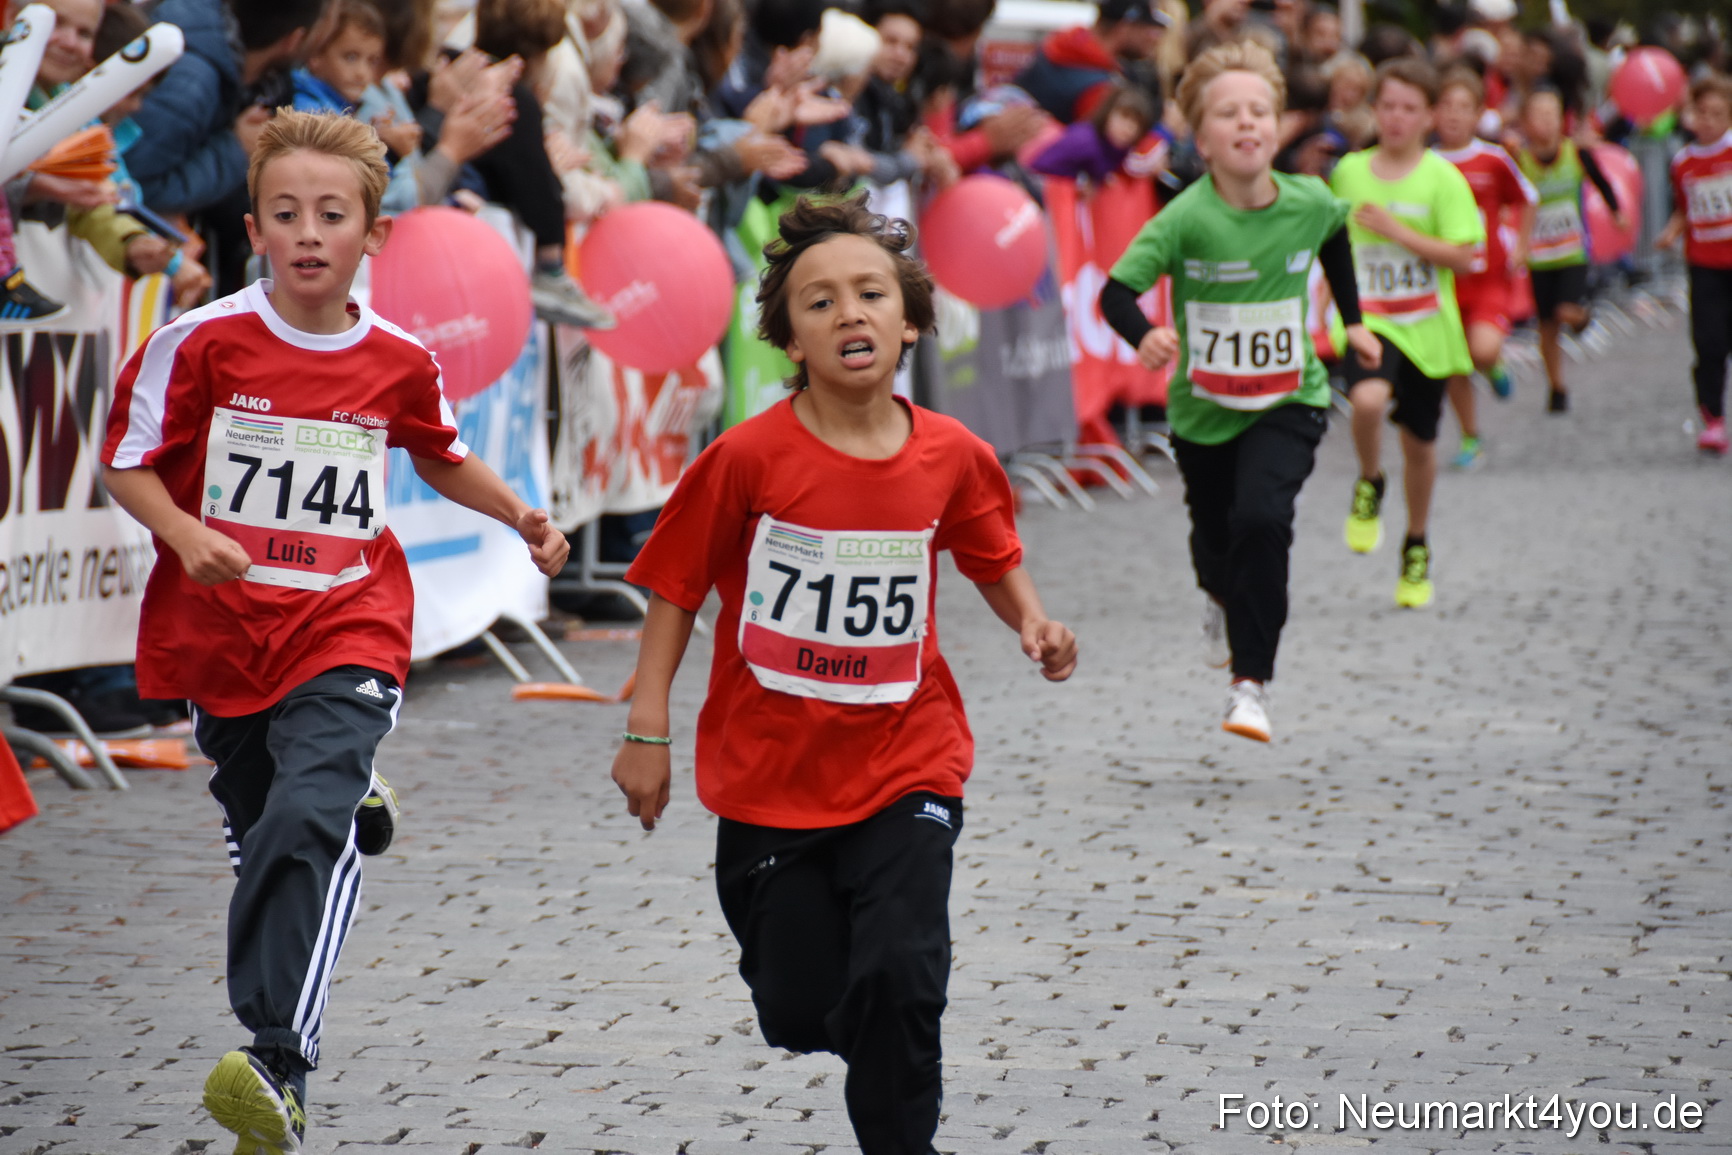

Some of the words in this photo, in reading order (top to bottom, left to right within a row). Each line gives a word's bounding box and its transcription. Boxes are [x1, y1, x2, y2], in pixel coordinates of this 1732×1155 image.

[1364, 257, 1431, 294] 7043
[1201, 328, 1294, 367] 7169
[229, 393, 271, 411] JAKO
[332, 411, 349, 423] FC
[225, 429, 284, 446] NeuerMarkt
[295, 425, 376, 453] BOCK
[228, 452, 374, 530] 7144
[209, 504, 216, 515] 6
[266, 536, 317, 565] Luis
[765, 537, 824, 559] NeuerMarkt
[836, 538, 923, 558] BOCK
[769, 560, 918, 637] 7155
[751, 610, 758, 621] 6
[796, 648, 868, 678] David
[356, 687, 383, 699] adidas
[923, 802, 950, 820] JAKO
